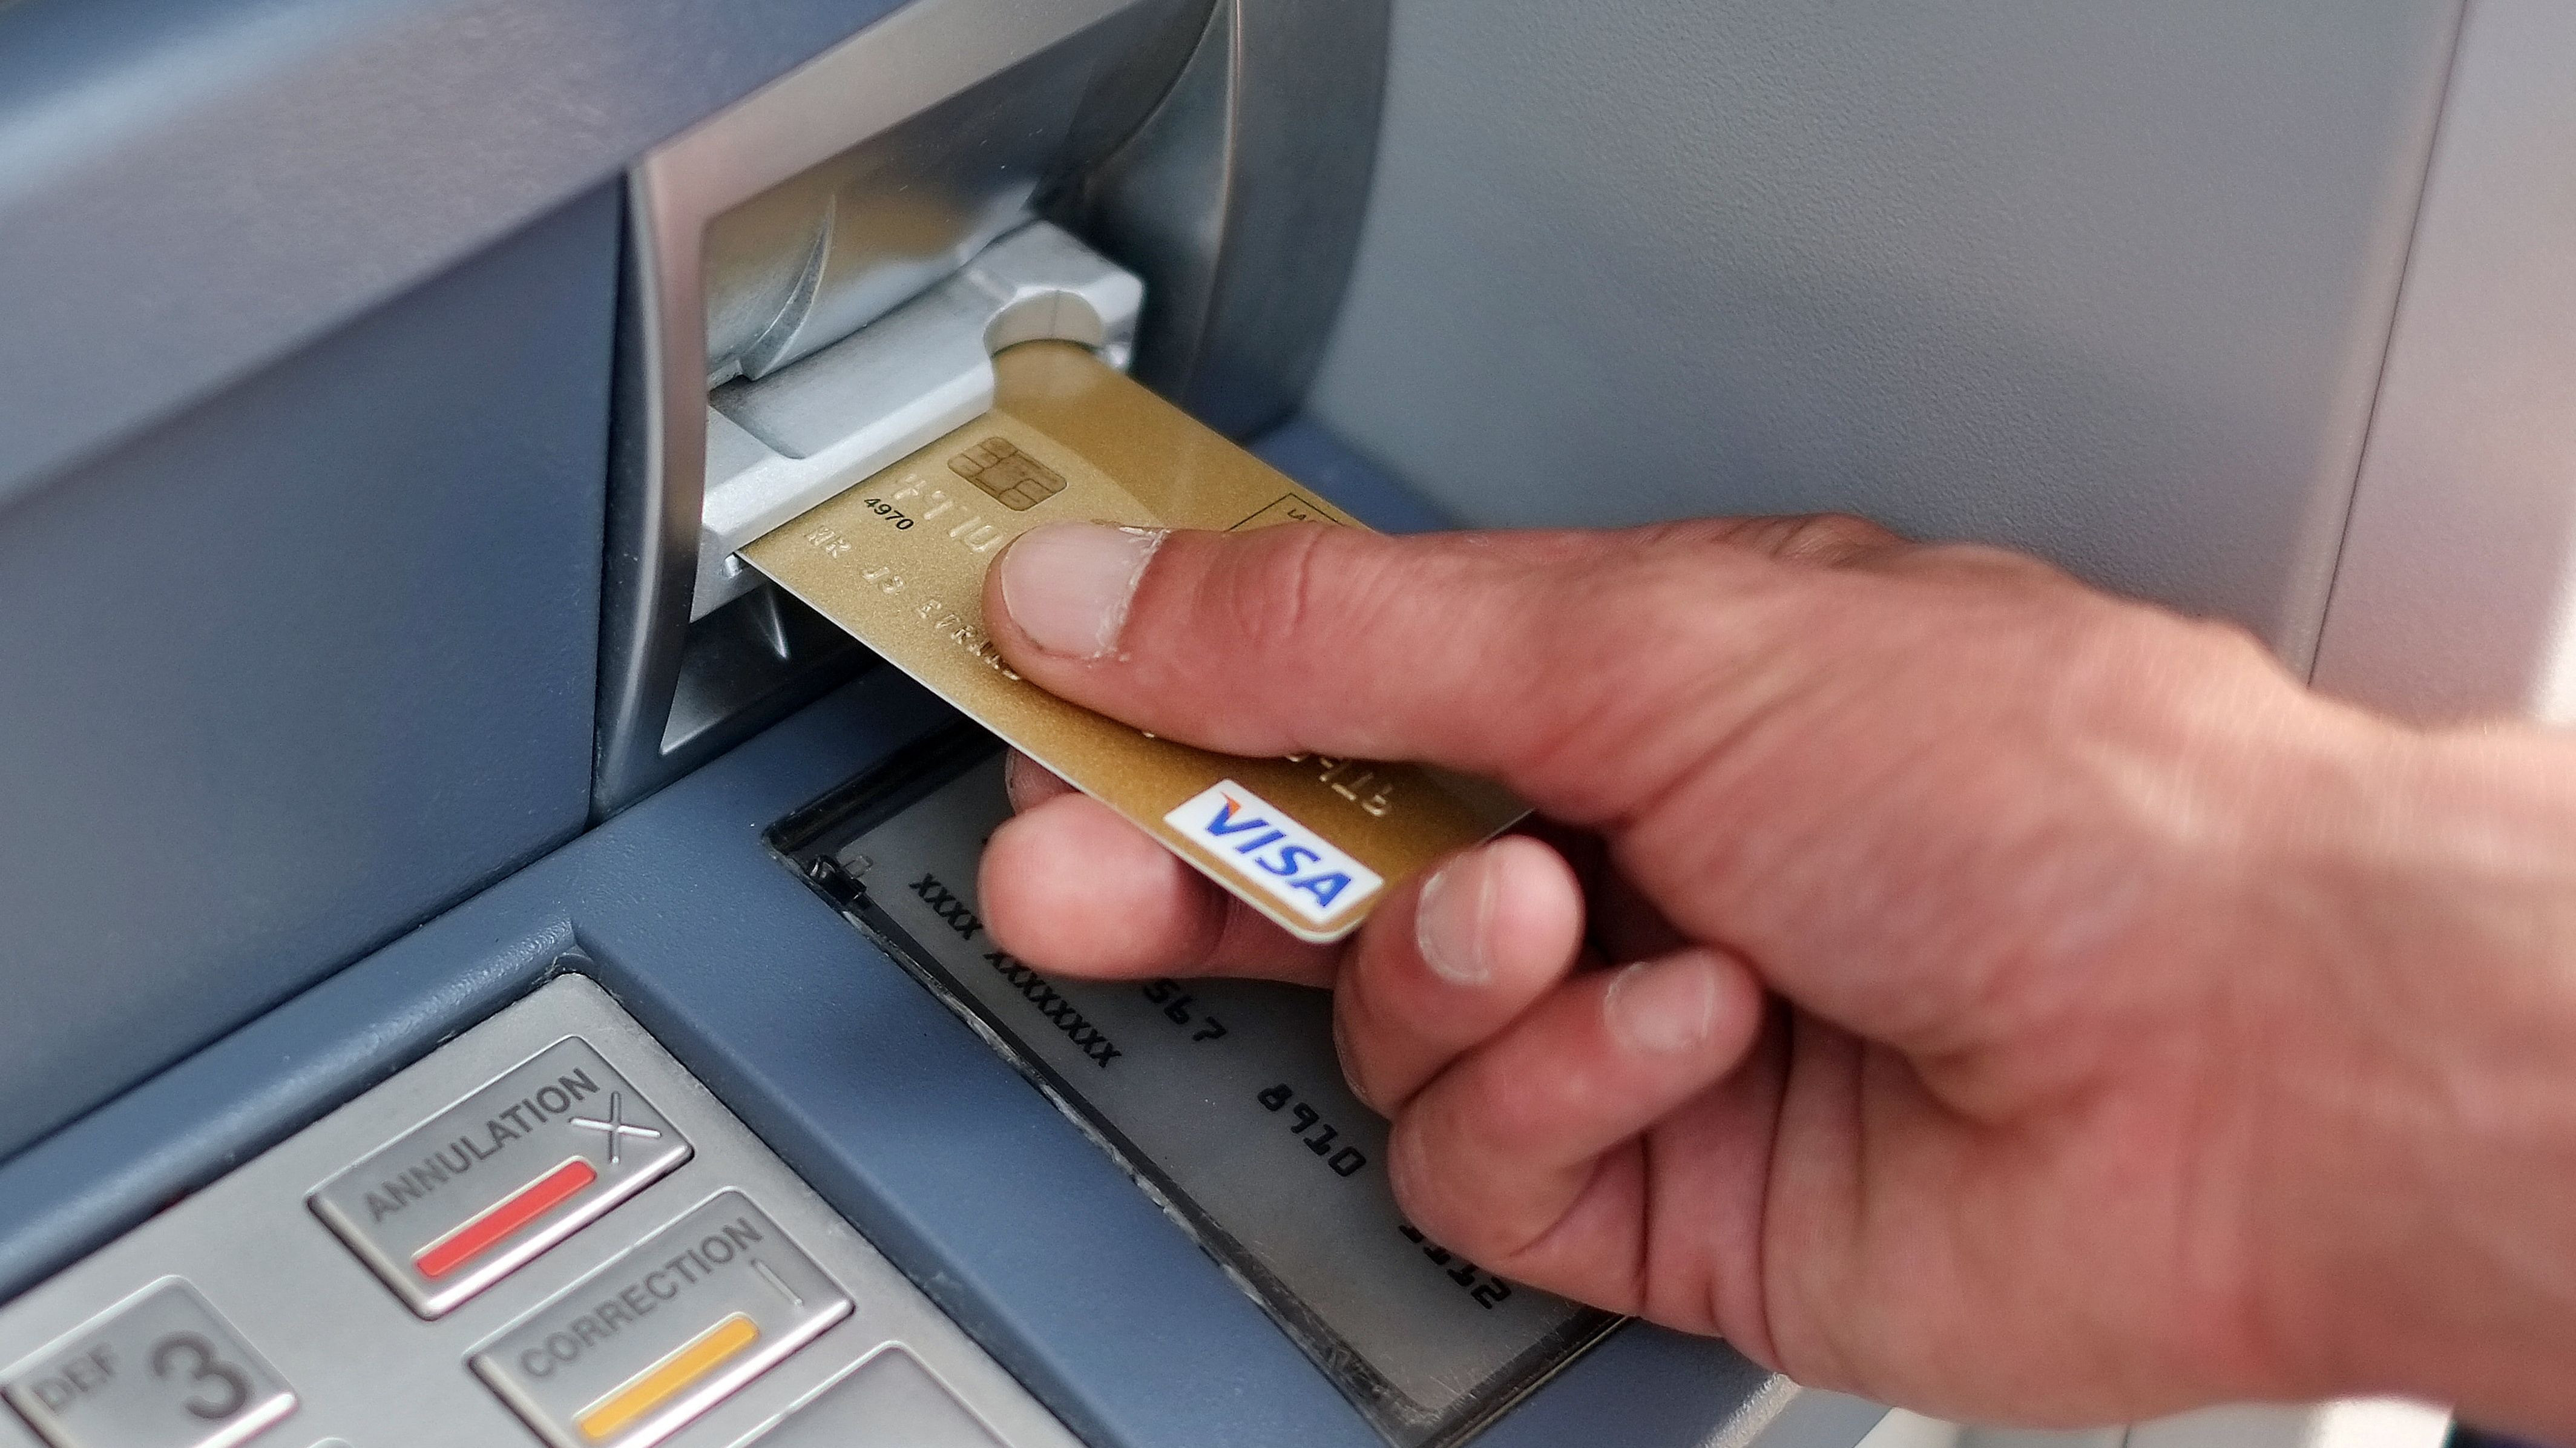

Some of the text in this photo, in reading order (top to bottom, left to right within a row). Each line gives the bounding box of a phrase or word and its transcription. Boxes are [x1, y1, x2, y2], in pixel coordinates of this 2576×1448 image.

[863, 497, 915, 531] 4970
[1204, 791, 1352, 909] VISA
[909, 872, 984, 941] XXXX
[366, 1066, 600, 1223] ANNULATION
[1257, 1083, 1367, 1177] 8910
[520, 1216, 764, 1378] CORRECTION
[30, 1331, 253, 1420] DEF 3
